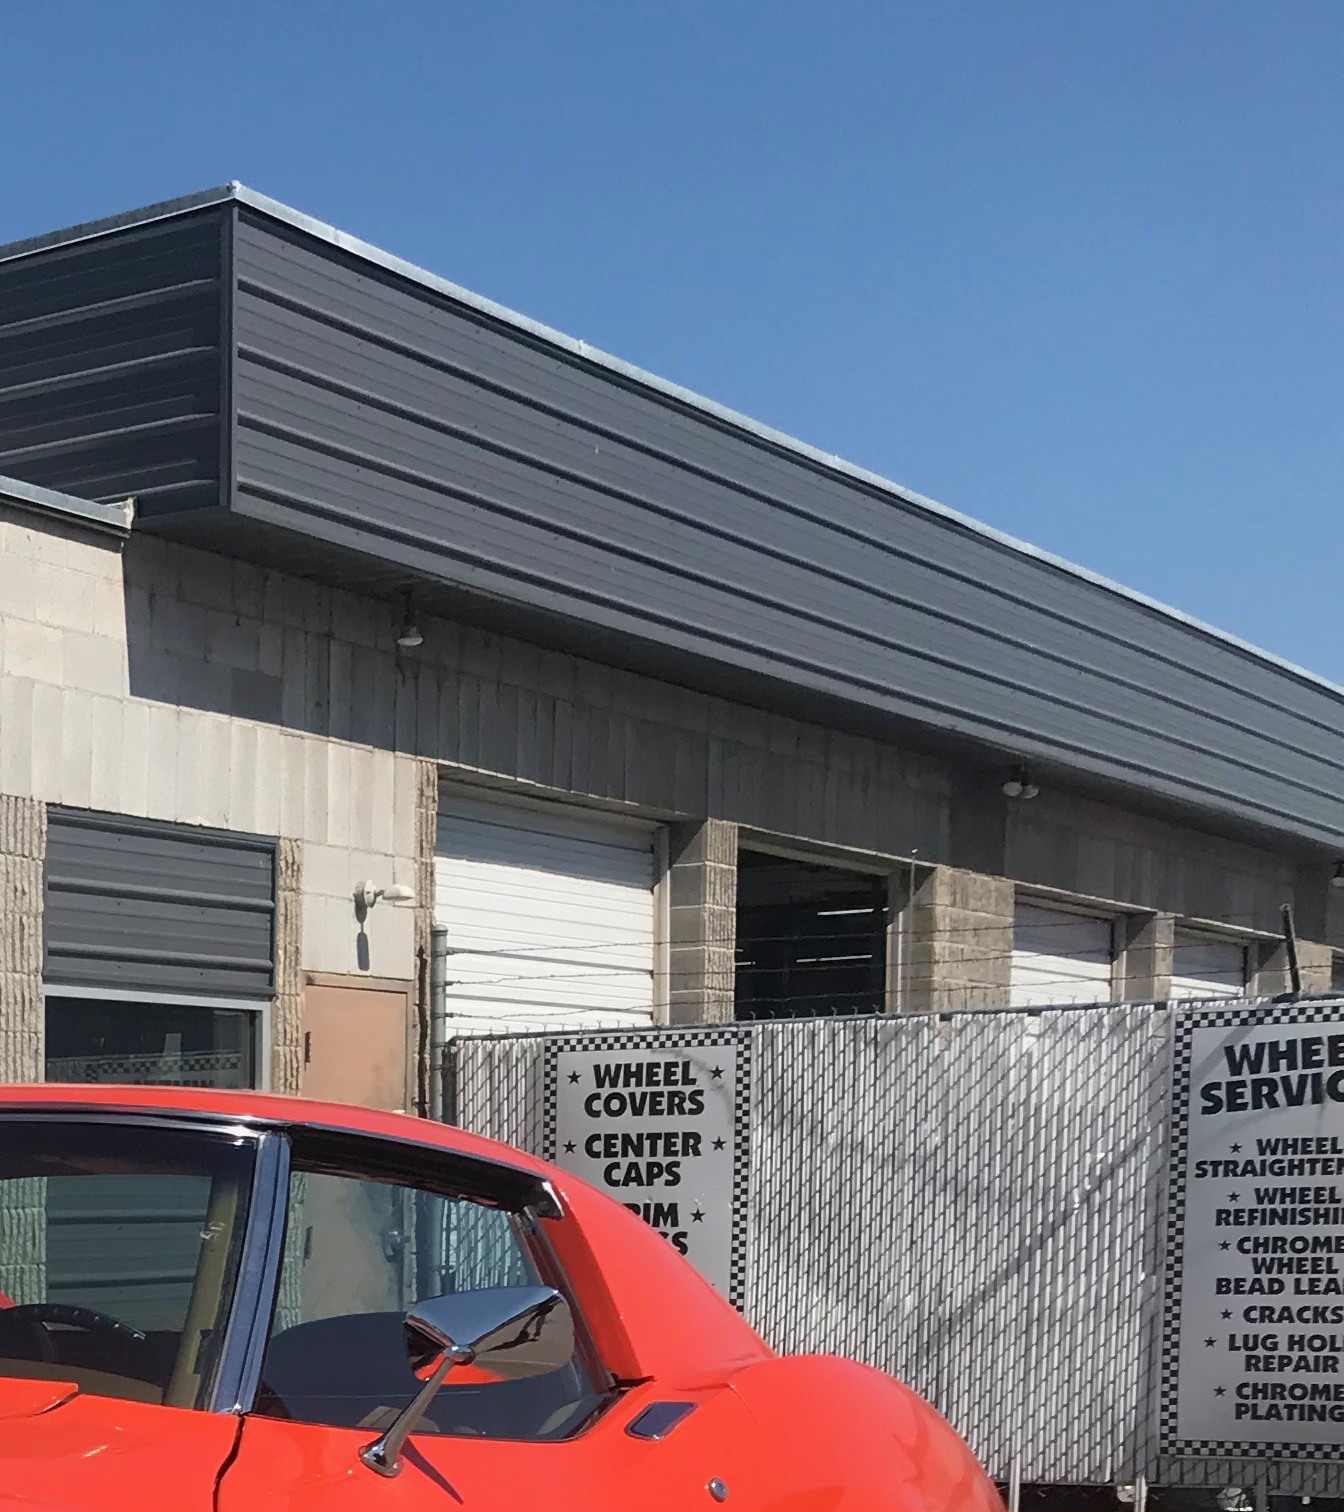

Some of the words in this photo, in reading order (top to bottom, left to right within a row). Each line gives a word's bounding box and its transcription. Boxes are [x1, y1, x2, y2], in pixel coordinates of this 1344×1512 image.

[593, 1061, 697, 1089] WHEEL
[584, 1089, 705, 1118] COVERS
[584, 1132, 702, 1159] CENTER
[1256, 1136, 1344, 1156] WHEEL
[603, 1161, 682, 1187] CAPS
[1254, 1186, 1342, 1205] WHEEL
[1215, 1206, 1344, 1226] REFINISHI
[1236, 1236, 1344, 1254] CHROME
[1252, 1256, 1340, 1274] WHEEL
[1215, 1277, 1285, 1295] BEAD
[1293, 1277, 1344, 1295] LEA
[1242, 1305, 1344, 1324] CRACKS
[1228, 1333, 1279, 1351] LUG
[1288, 1333, 1344, 1352] HOL
[1244, 1354, 1340, 1373] REPAIR
[1235, 1382, 1344, 1401] CHROME
[1235, 1402, 1344, 1423] PLATING
